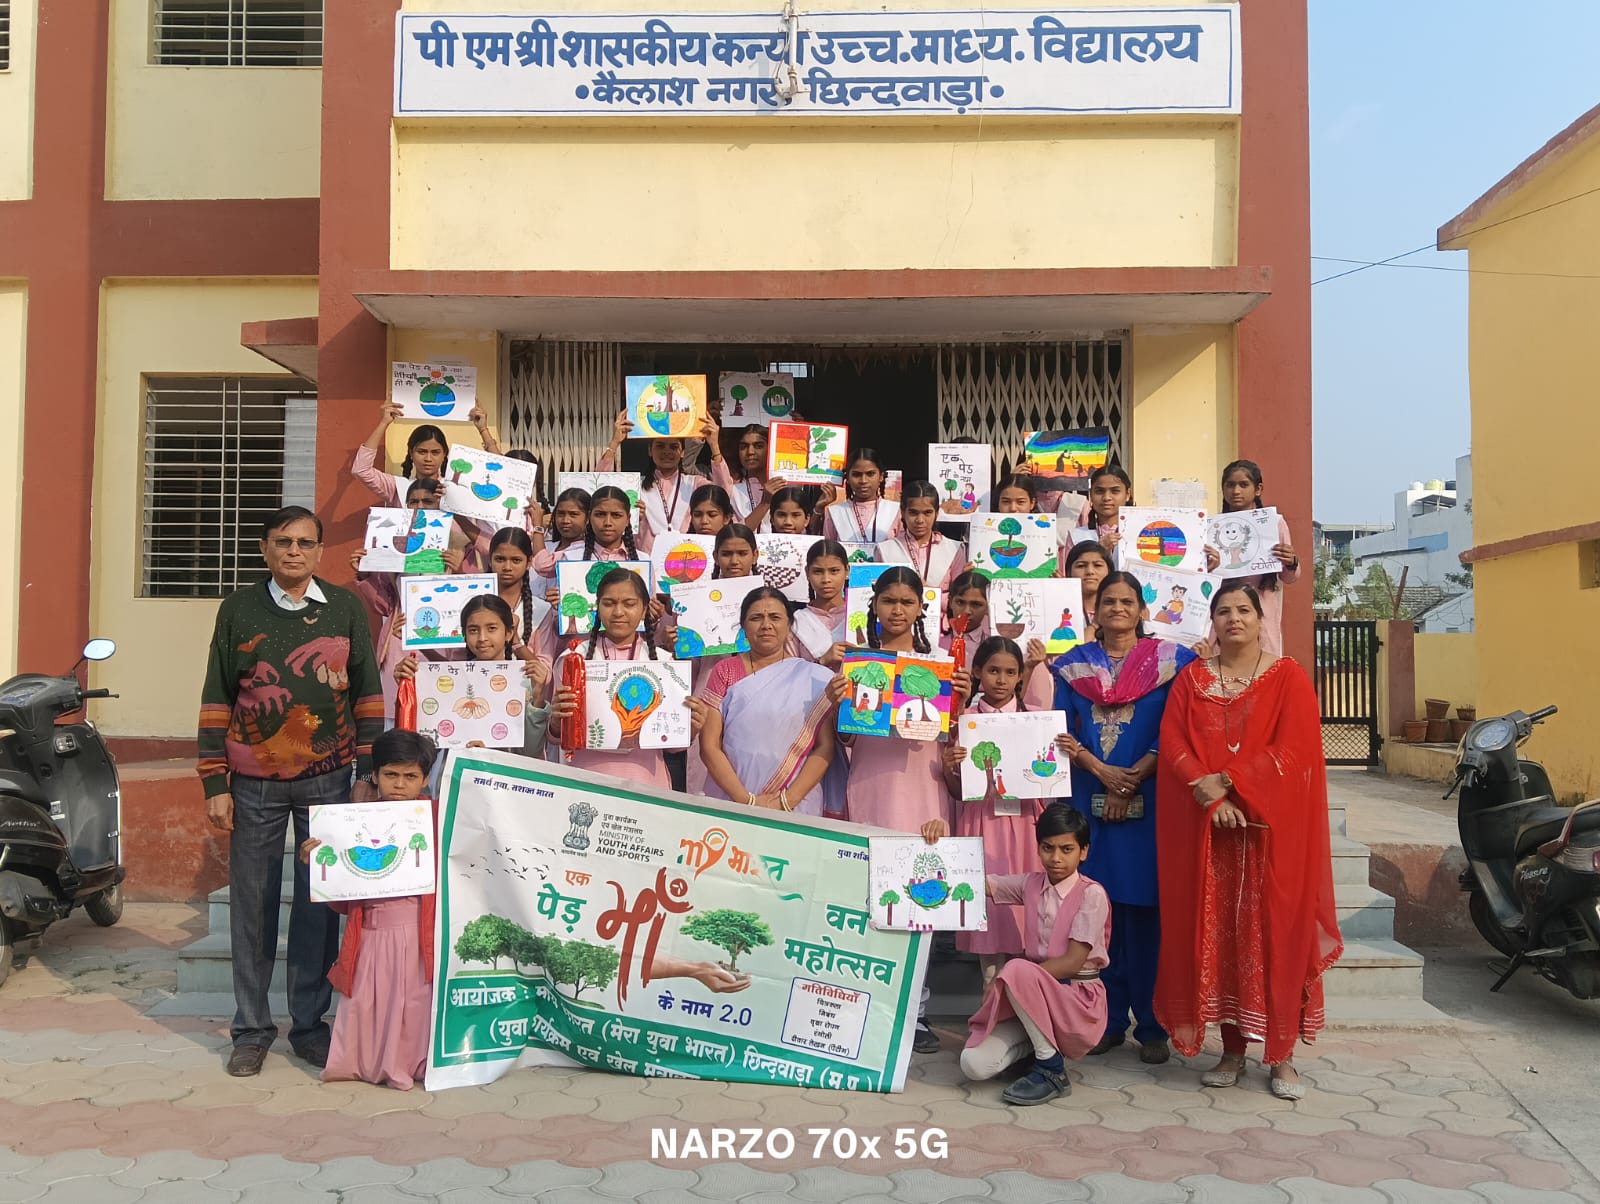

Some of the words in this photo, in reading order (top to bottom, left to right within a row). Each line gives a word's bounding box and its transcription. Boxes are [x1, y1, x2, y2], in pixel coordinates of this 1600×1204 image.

[412, 19, 458, 68] पी
[1028, 15, 1204, 63] विद्यालय
[591, 70, 699, 106] कैलाश
[803, 67, 989, 113] छिन्दवाड़ा
[595, 846, 616, 856] AND
[617, 849, 650, 863] SPORTS
[598, 837, 628, 850] YOUTH
[630, 843, 665, 857] AFFAIRS
[599, 829, 634, 842] MINISTRY
[634, 836, 646, 844] OF
[564, 869, 592, 887] एक
[537, 883, 587, 934] पेड़
[826, 904, 869, 936] वन
[784, 936, 897, 985] महोत्सव
[450, 981, 516, 1007] आयोजक
[657, 989, 675, 1011] के
[681, 998, 715, 1019] नाम
[718, 1004, 752, 1026] 2.0
[489, 1017, 529, 1046] (युवा
[577, 1046, 602, 1064] एवं
[606, 1050, 639, 1075] खेल
[601, 1017, 641, 1045] (मेरा
[646, 1030, 679, 1054] युवा
[685, 1035, 735, 1069] भारत)
[742, 1045, 815, 1087] छिन्दवाड़ा
